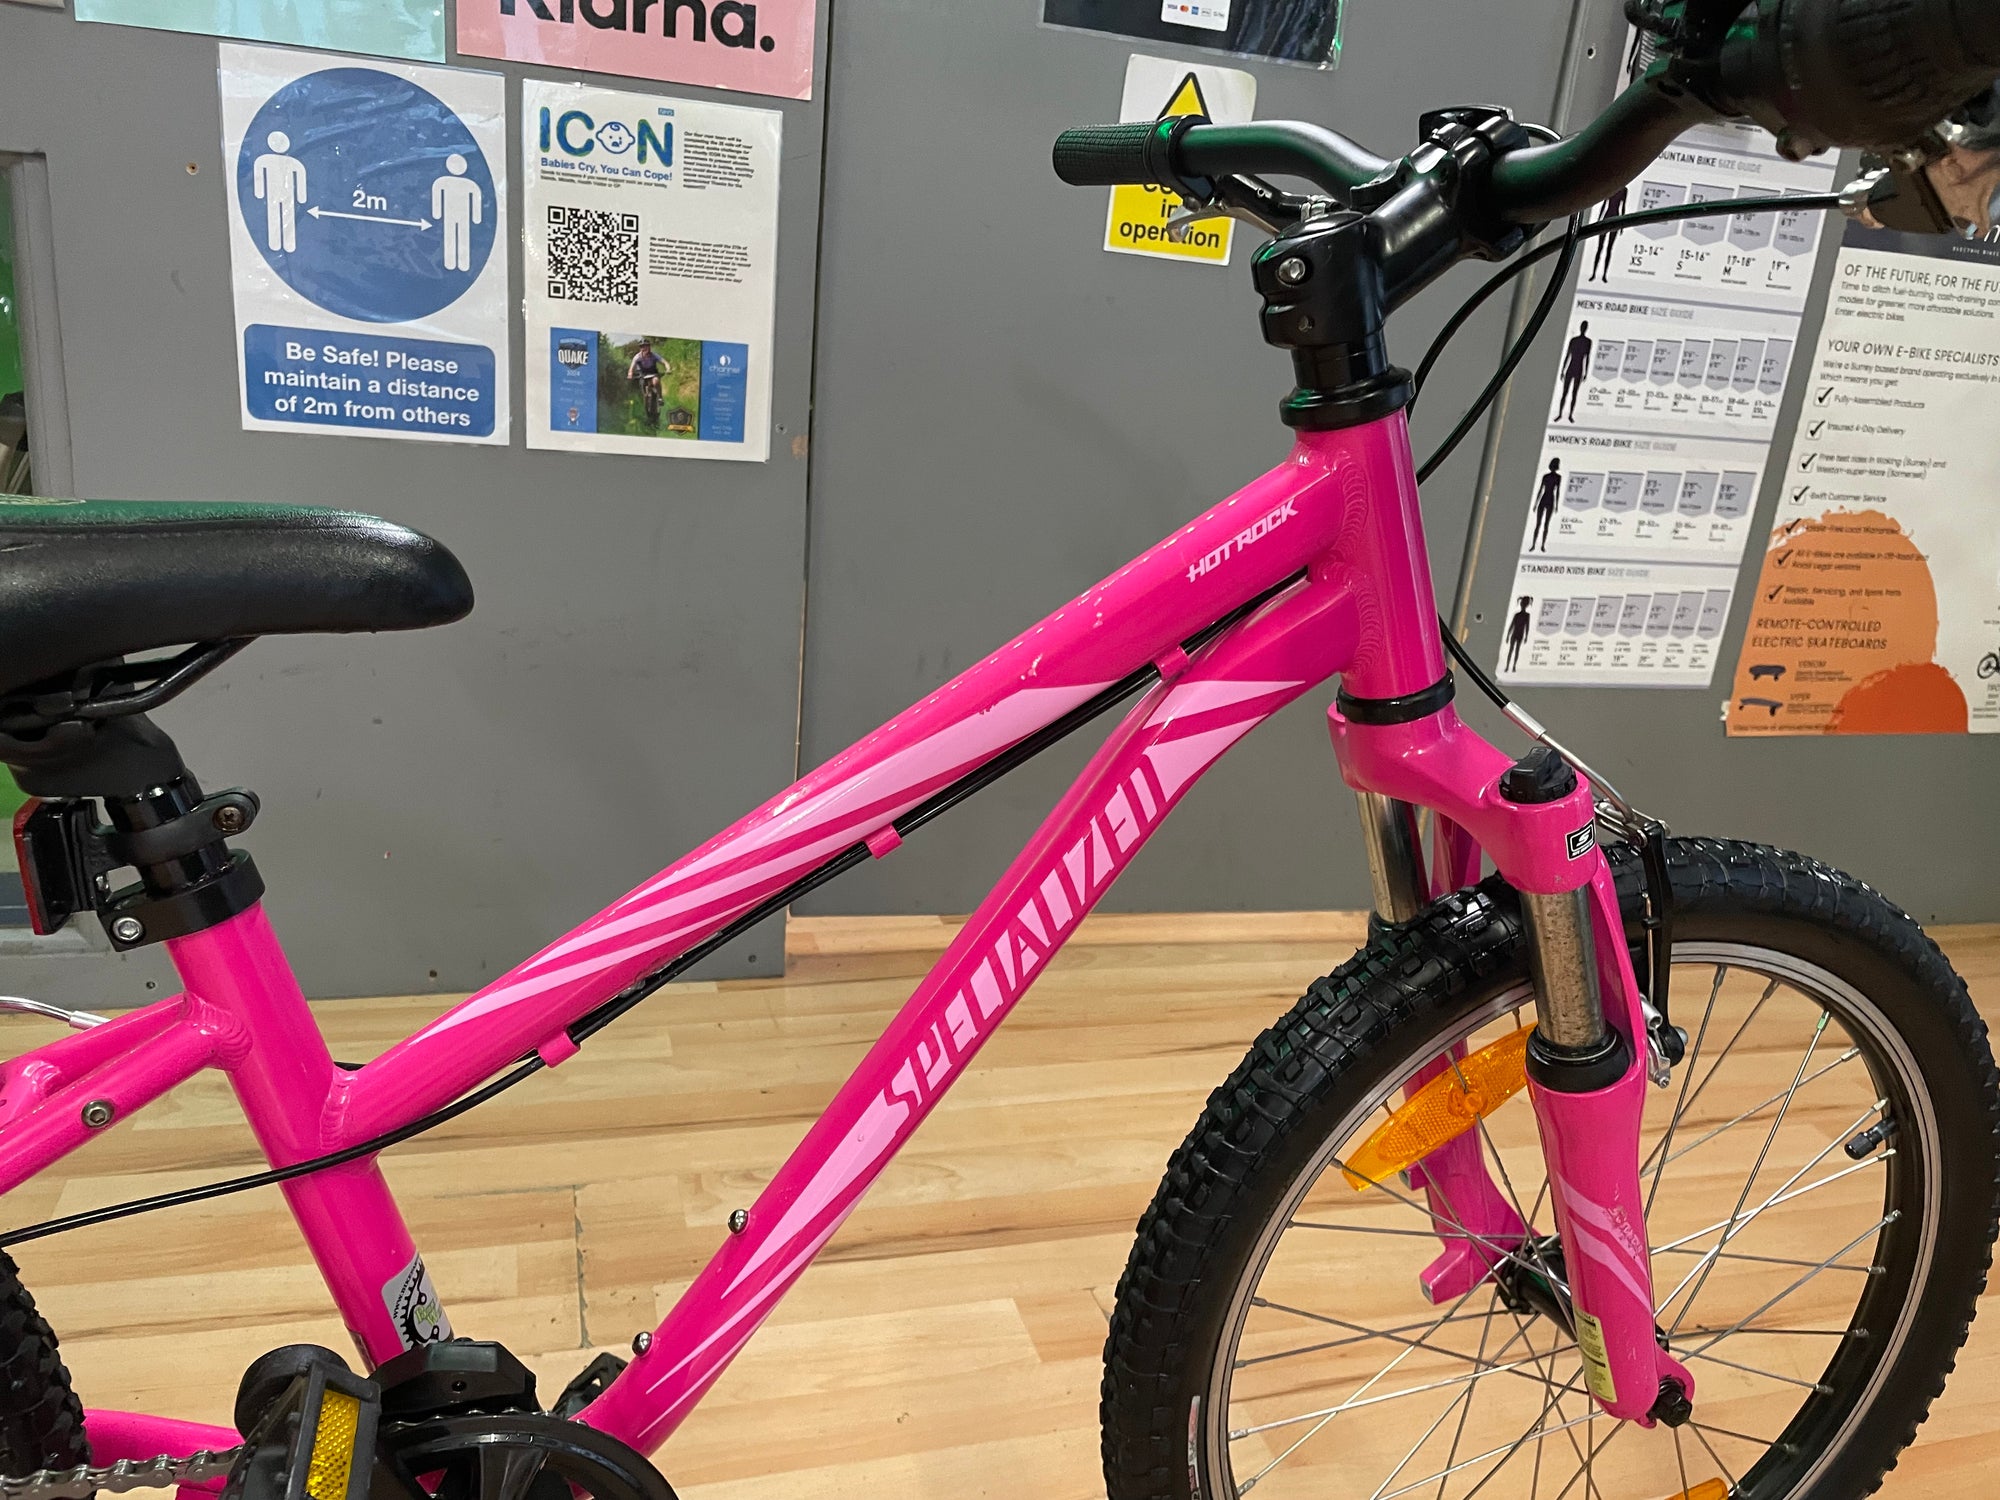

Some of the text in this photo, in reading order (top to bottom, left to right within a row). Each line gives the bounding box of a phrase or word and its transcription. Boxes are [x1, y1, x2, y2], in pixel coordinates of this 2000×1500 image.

[500, 0, 775, 52] arna.
[1658, 150, 1695, 163] OUNTAIN
[1696, 155, 1717, 167] BIKE
[1718, 158, 1736, 170] SIZE
[541, 157, 575, 170] Babies
[578, 161, 598, 174] Cry,
[600, 164, 619, 175] You
[622, 168, 642, 177] Can
[643, 169, 673, 181] Cope!
[353, 189, 387, 210] 2m
[1120, 221, 1219, 248] operion
[1630, 257, 1642, 266] XS
[1680, 249, 1711, 262] 15-16"
[1727, 254, 1756, 267] 17-18"
[1676, 261, 1683, 270] S
[1723, 266, 1732, 276] M
[1767, 272, 1773, 281] L
[1844, 264, 2000, 293] OF THE FUTURE, FOR THE FU
[1577, 300, 1603, 310] MEN'S
[1604, 302, 1628, 313] ROAD
[1629, 304, 1649, 315] BIKE
[286, 341, 458, 374] Be Safe! Please
[557, 349, 589, 366] QUAKE
[1828, 339, 2000, 366] YOUR OWN E-BIKE SPECIALISTS
[264, 370, 480, 402] maintain a distance
[275, 395, 471, 427] of 2m from others
[1548, 435, 1587, 446] WOMEN'S
[1588, 437, 1612, 447] ROAD
[1613, 439, 1632, 449] BIKE
[1521, 564, 1565, 574] STANDARD
[1566, 566, 1586, 575] KIDS
[1587, 567, 1606, 576] BIKE
[1756, 618, 1882, 632] REMOTE-CONTROLLED
[1751, 636, 1888, 649] ELECTRIC SKATEBOARDS
